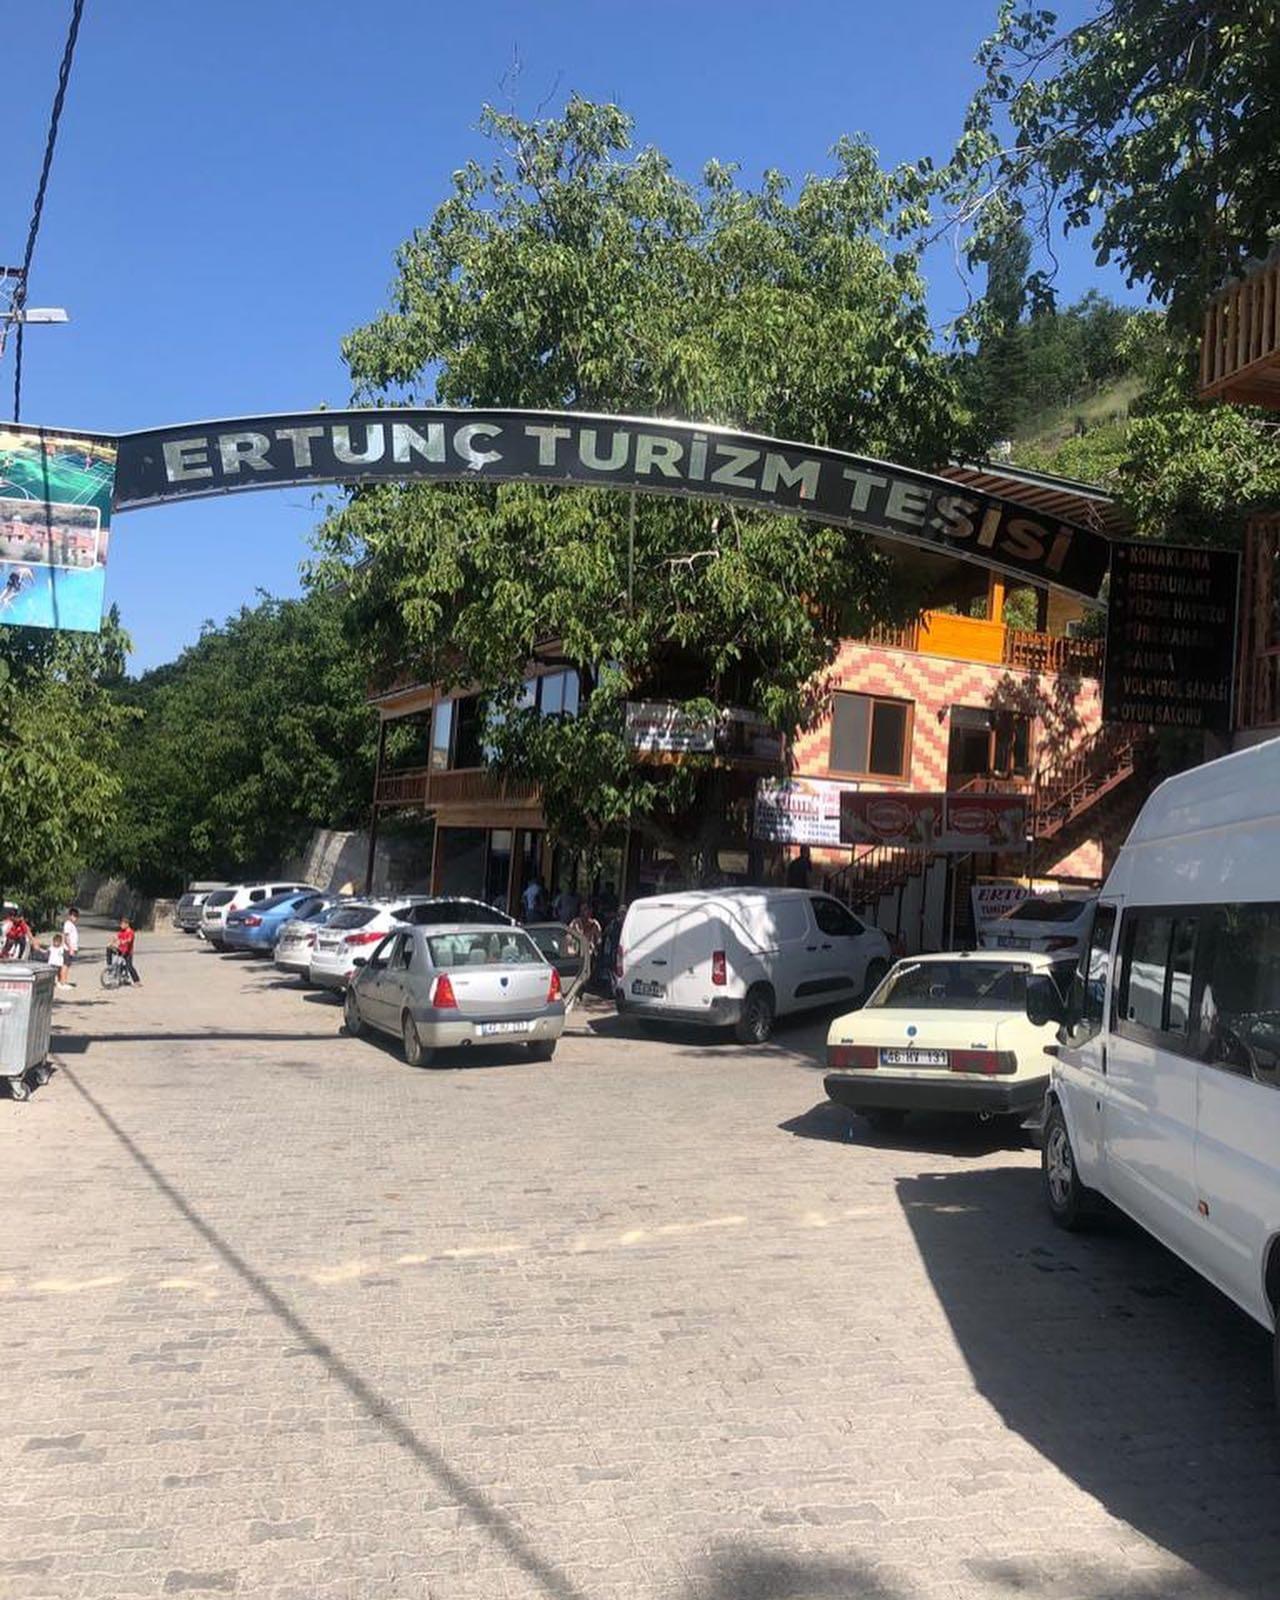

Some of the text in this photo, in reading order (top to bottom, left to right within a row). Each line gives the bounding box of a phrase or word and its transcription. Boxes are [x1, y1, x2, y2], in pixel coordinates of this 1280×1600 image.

[162, 423, 1075, 572] ERTUNÇ TURİZM TESİSİ
[1129, 545, 1211, 571] KONAKLAMA
